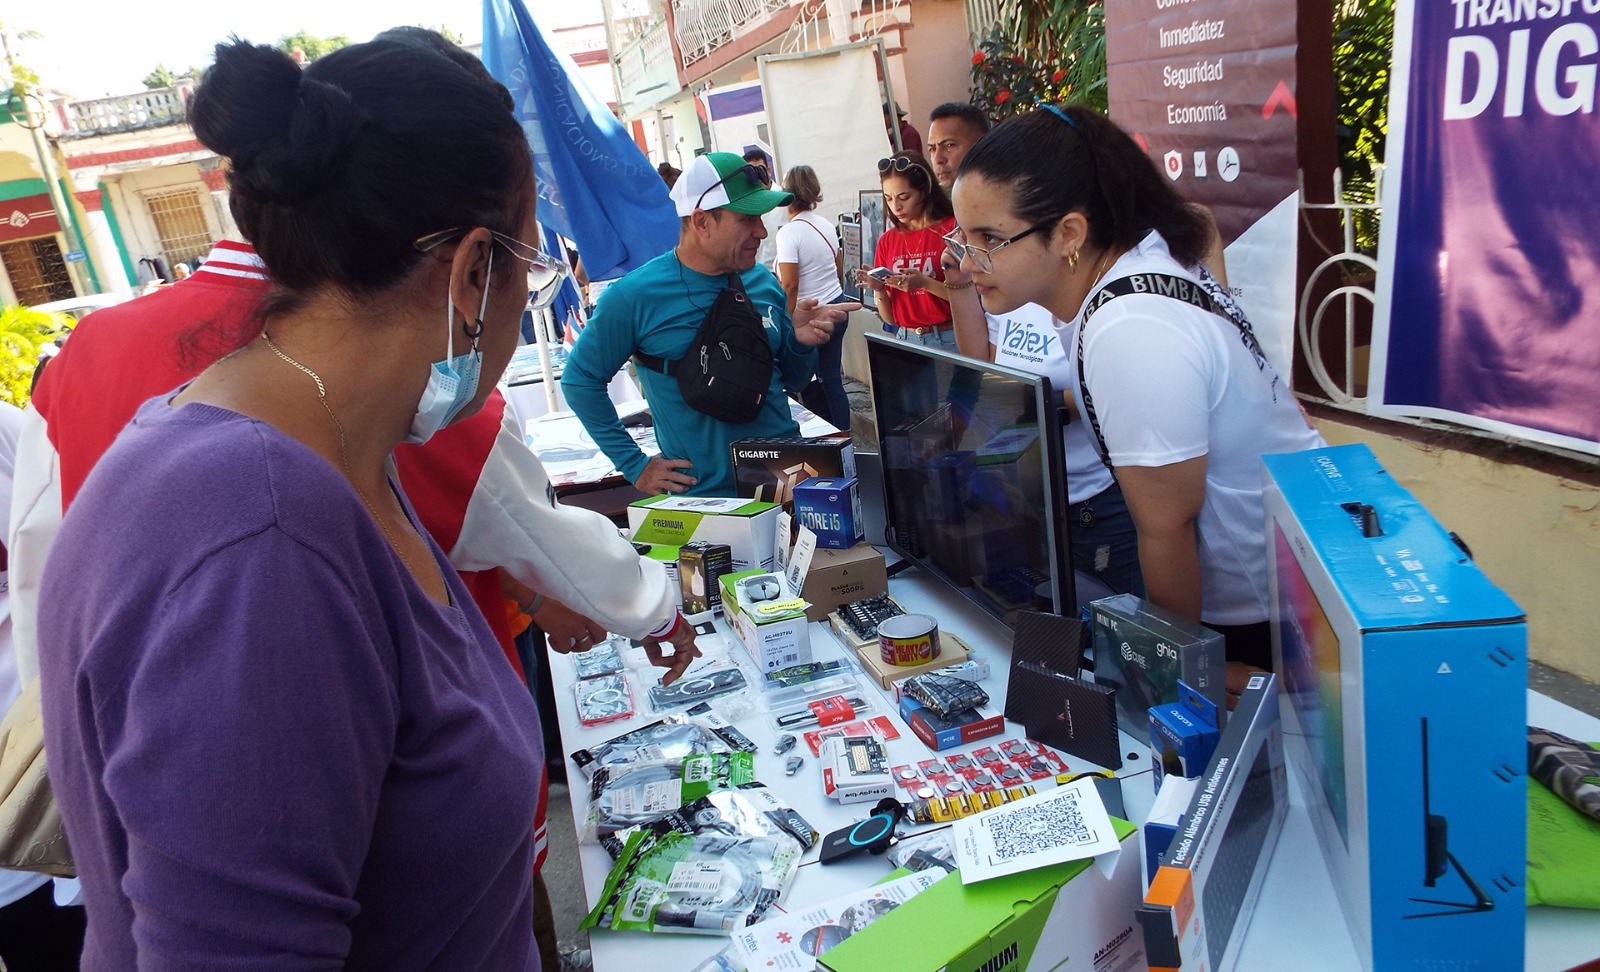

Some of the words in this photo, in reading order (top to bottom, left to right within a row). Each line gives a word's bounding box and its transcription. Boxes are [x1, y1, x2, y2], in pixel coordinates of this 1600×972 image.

[1159, 19, 1225, 48] Inmediatez
[1163, 58, 1224, 89] Seguridad
[1443, 22, 1599, 121] DIG
[1167, 100, 1227, 125] Economía
[1129, 274, 1203, 308] BIMBA
[739, 450, 779, 459] GIGABYTE
[652, 518, 685, 530] PREMIUM
[800, 512, 829, 530] CORE
[829, 513, 841, 531] i5
[895, 643, 919, 655] HEAVY
[898, 651, 918, 663] DUTY
[1156, 642, 1178, 660] ghia
[1171, 838, 1193, 865] Teclado
[1184, 806, 1206, 839] Alámbrico
[1197, 793, 1212, 808] USB
